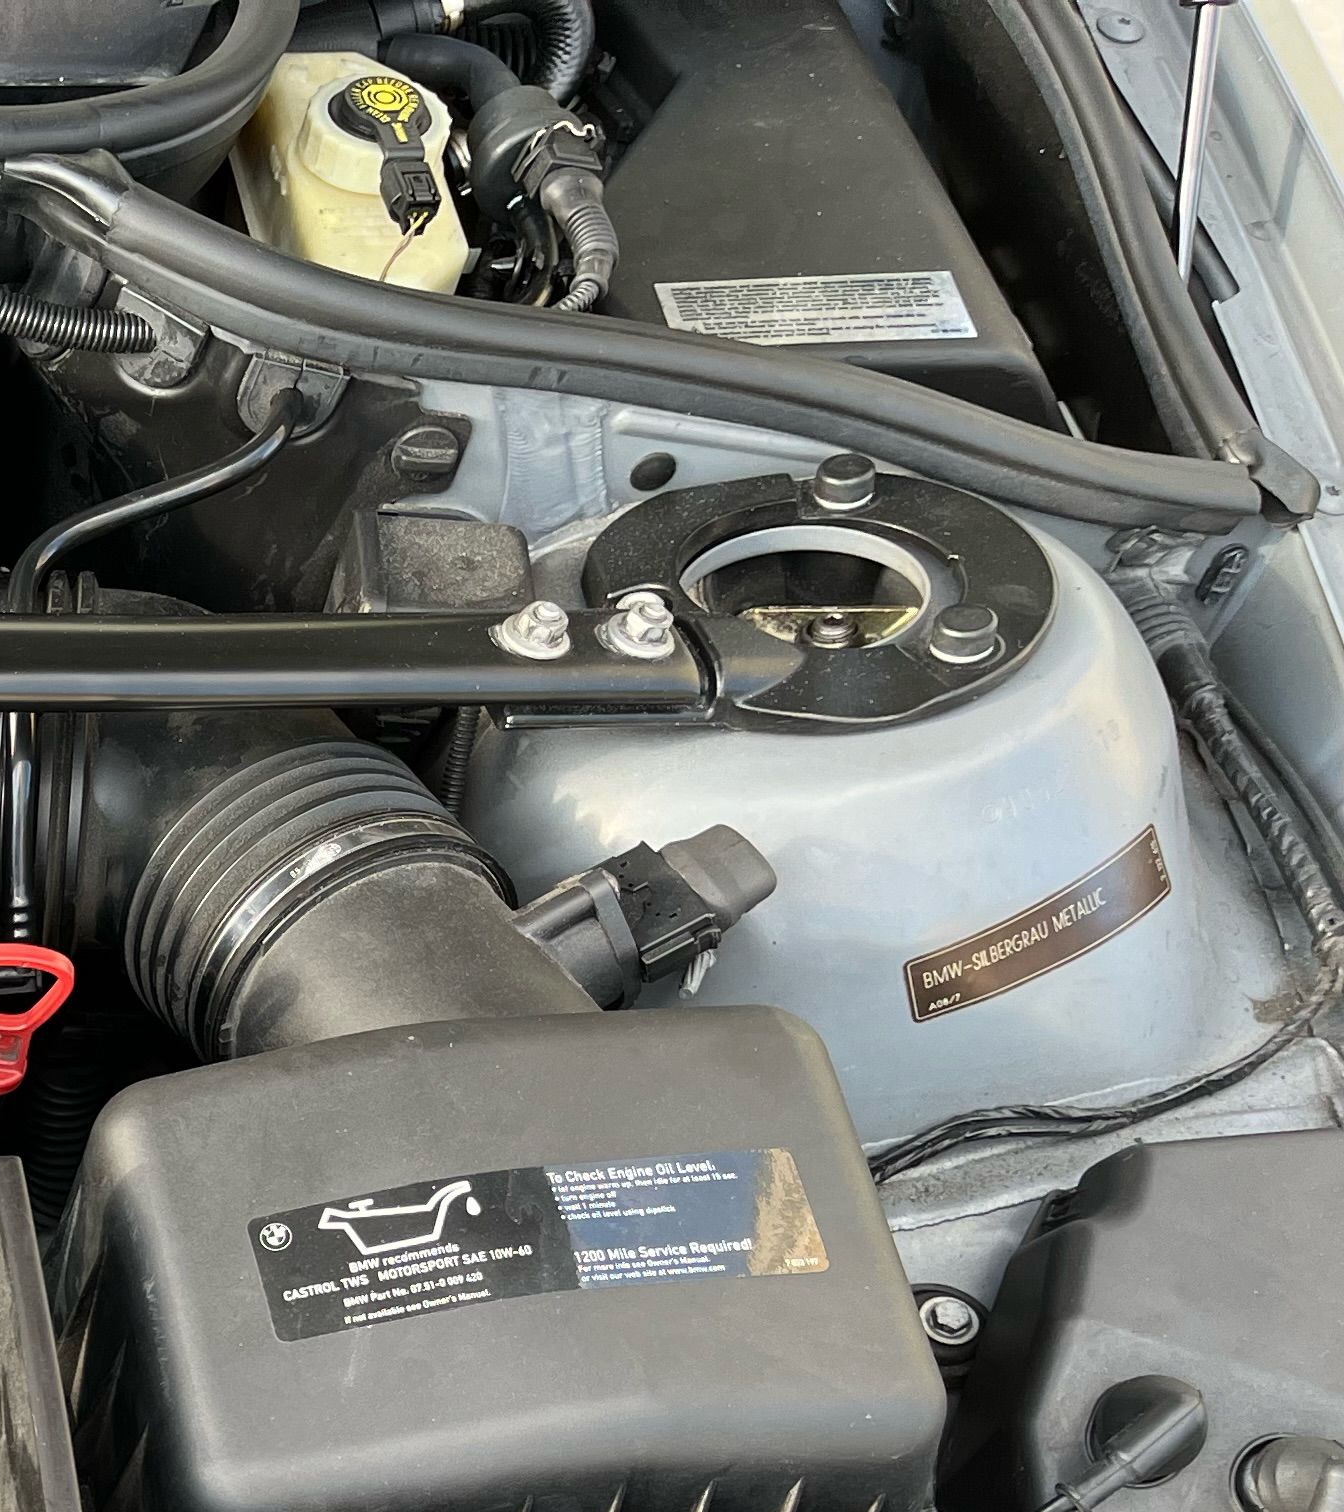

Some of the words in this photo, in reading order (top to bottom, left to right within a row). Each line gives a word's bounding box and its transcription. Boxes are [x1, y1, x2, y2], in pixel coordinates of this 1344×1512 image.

[922, 921, 1050, 989] BMW-SILBERGRAU
[1051, 887, 1107, 933] METALLIC
[545, 1172, 563, 1184] To
[564, 1168, 606, 1183] Check
[606, 1165, 653, 1181] Engine
[655, 1162, 675, 1175] Oil
[569, 1182, 596, 1193] engine
[597, 1181, 620, 1189] warm
[668, 1175, 681, 1184] for
[682, 1174, 691, 1183] at
[691, 1172, 711, 1182] least
[560, 1193, 578, 1202] turn
[578, 1192, 606, 1201] engine
[606, 1190, 617, 1199] off
[563, 1202, 581, 1211] wait
[588, 1201, 616, 1209] minute
[567, 1211, 590, 1220] check
[591, 1210, 602, 1219] oil
[602, 1208, 622, 1218] level
[622, 1207, 645, 1217] using
[645, 1204, 676, 1215] dipstick
[348, 1257, 380, 1273] BMW
[381, 1242, 461, 1267] recommends
[574, 1249, 606, 1264] 1200
[607, 1247, 637, 1261] Mile
[637, 1244, 688, 1259] Service
[689, 1237, 753, 1255] Required!
[282, 1280, 341, 1302] CASTROL
[340, 1274, 370, 1290] TWS
[377, 1255, 460, 1282] MOTORSPORT
[461, 1250, 488, 1265] SAE
[488, 1244, 533, 1261] 10W-60
[577, 1264, 592, 1273] For
[593, 1263, 614, 1272] more
[631, 1261, 646, 1269] see
[646, 1258, 680, 1268] Owner's
[581, 1274, 591, 1283] or
[591, 1273, 609, 1281] visit
[609, 1272, 623, 1281] our
[624, 1270, 642, 1279] web
[642, 1269, 657, 1277] site
[658, 1268, 667, 1276] at
[667, 1264, 726, 1275] www.bmw.com
[342, 1293, 370, 1308] BMW
[370, 1290, 392, 1303] Part
[391, 1287, 410, 1298] No.
[352, 1312, 367, 1323] not
[367, 1304, 405, 1320] available
[405, 1301, 422, 1312] see
[422, 1295, 458, 1309] Owner's
[457, 1287, 492, 1301] Manual.
